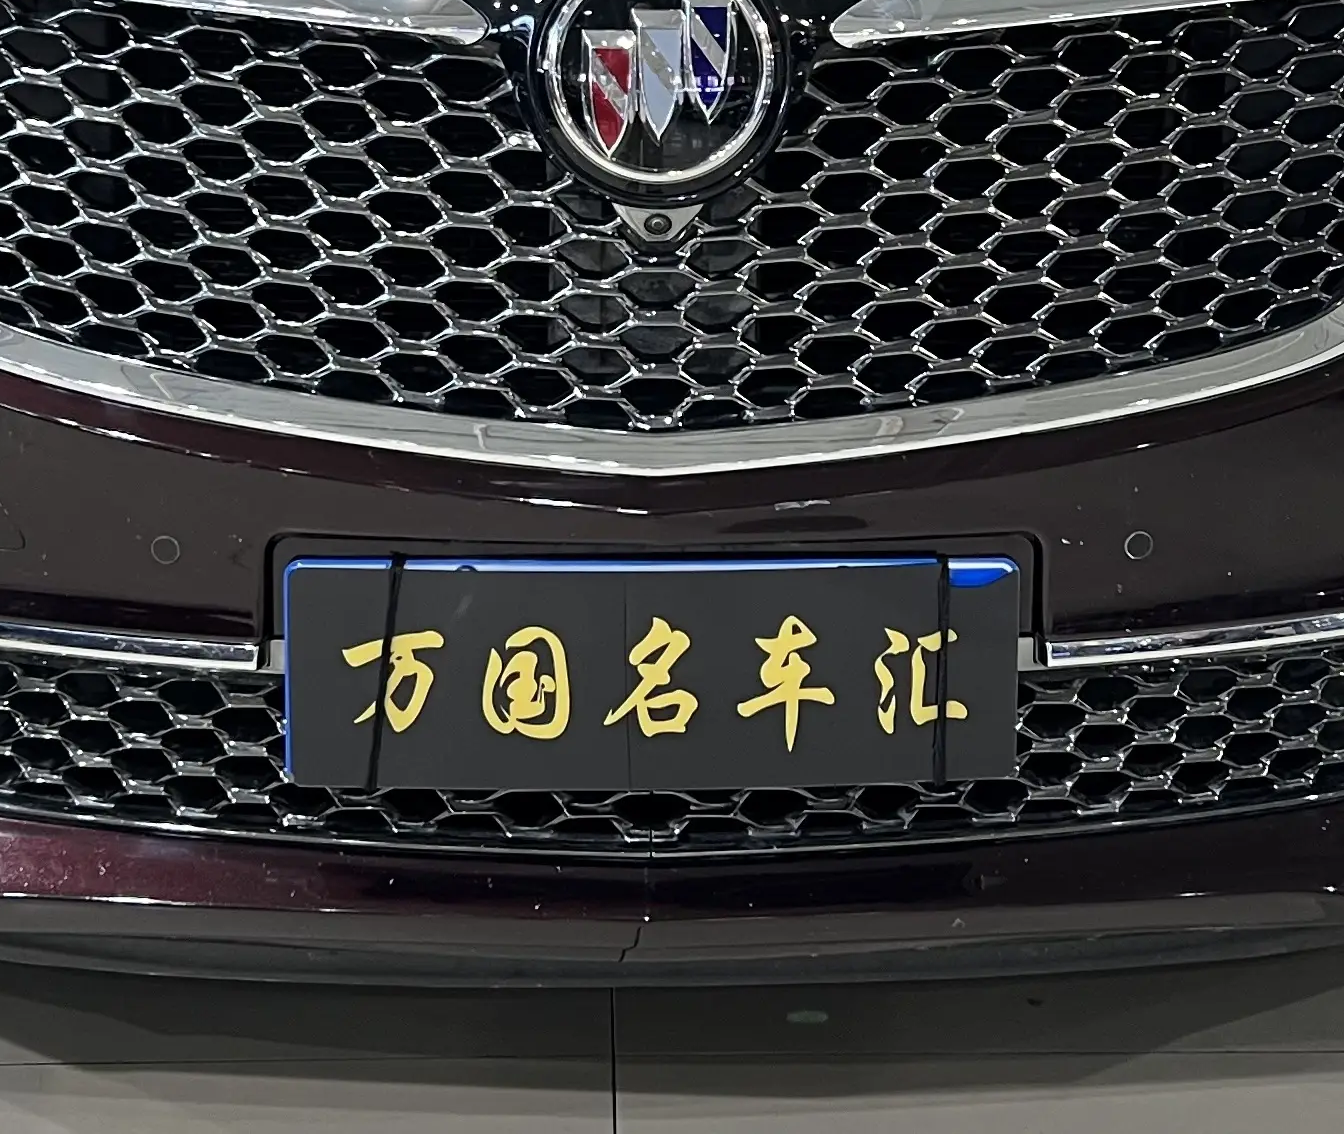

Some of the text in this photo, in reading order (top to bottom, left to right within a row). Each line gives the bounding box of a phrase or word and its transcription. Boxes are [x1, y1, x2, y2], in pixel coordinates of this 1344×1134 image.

[341, 614, 969, 753] 万国名车汇
